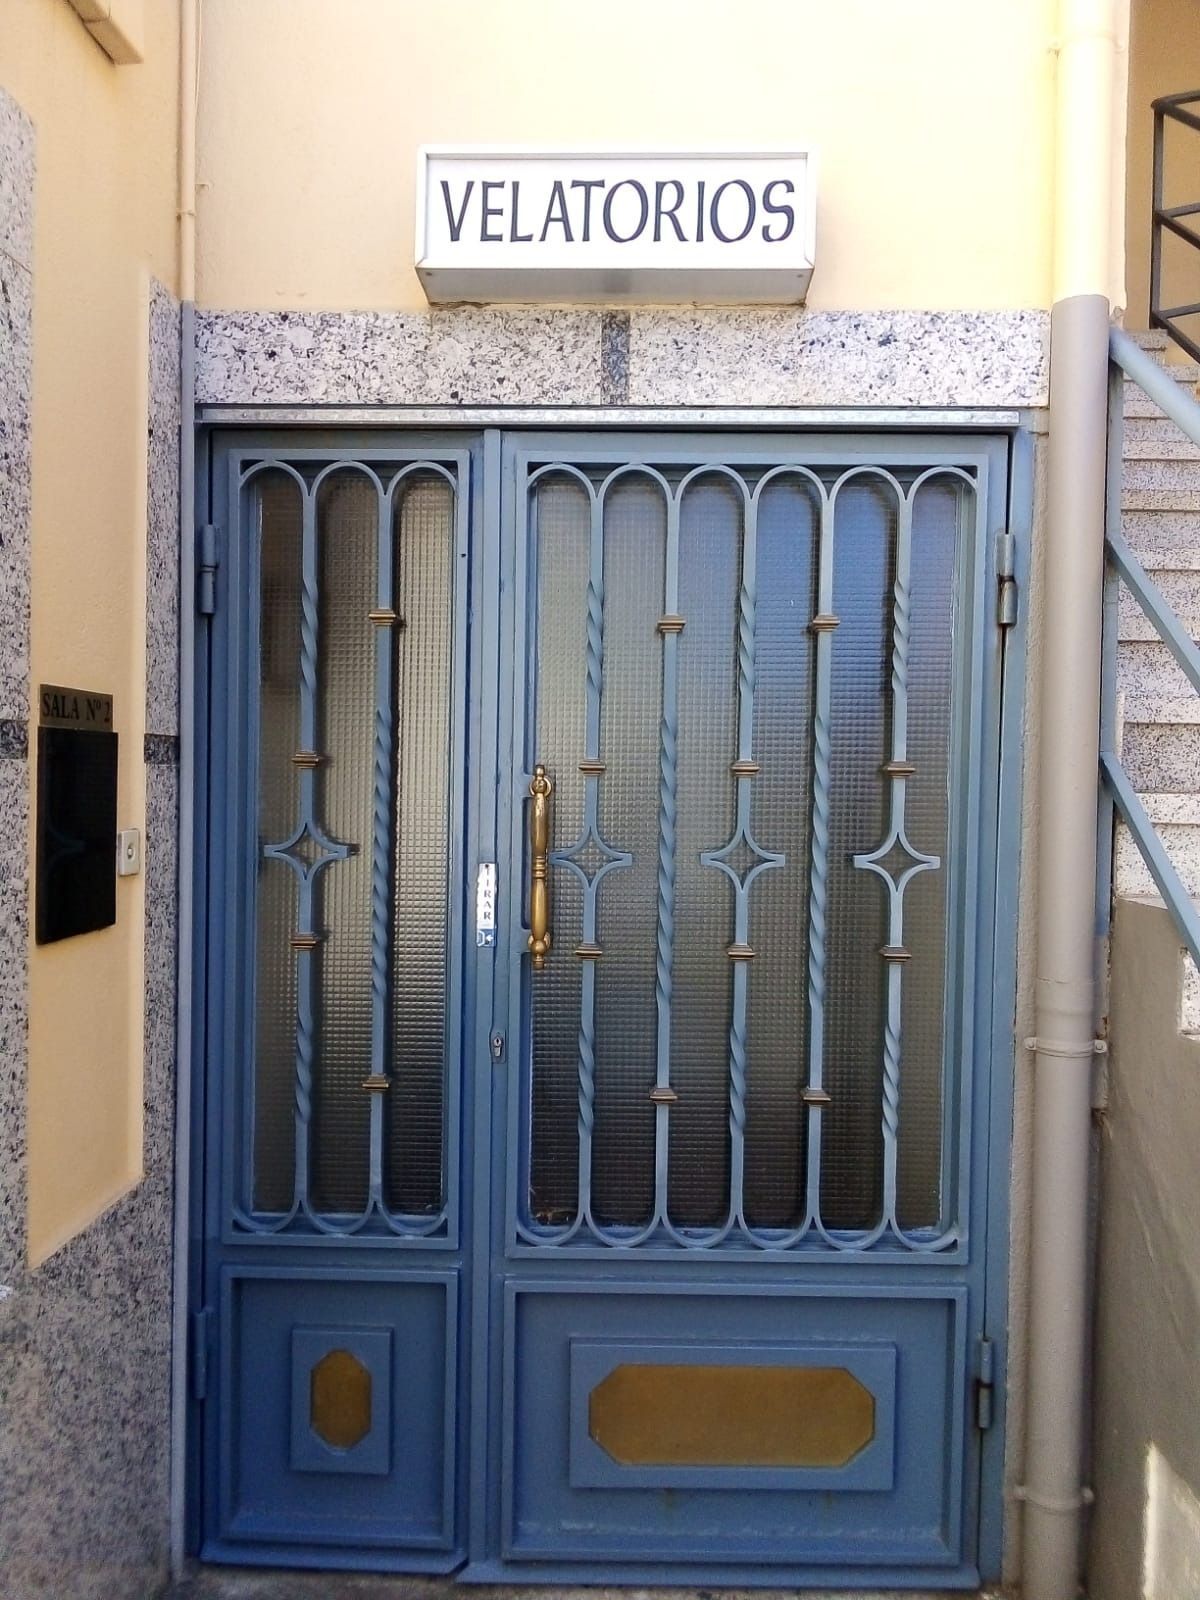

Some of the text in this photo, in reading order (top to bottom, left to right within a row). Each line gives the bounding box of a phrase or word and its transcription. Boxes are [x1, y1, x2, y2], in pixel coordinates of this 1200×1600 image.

[440, 179, 796, 243] VELATORIOS
[42, 692, 80, 721] SALA
[103, 701, 111, 723] 2
